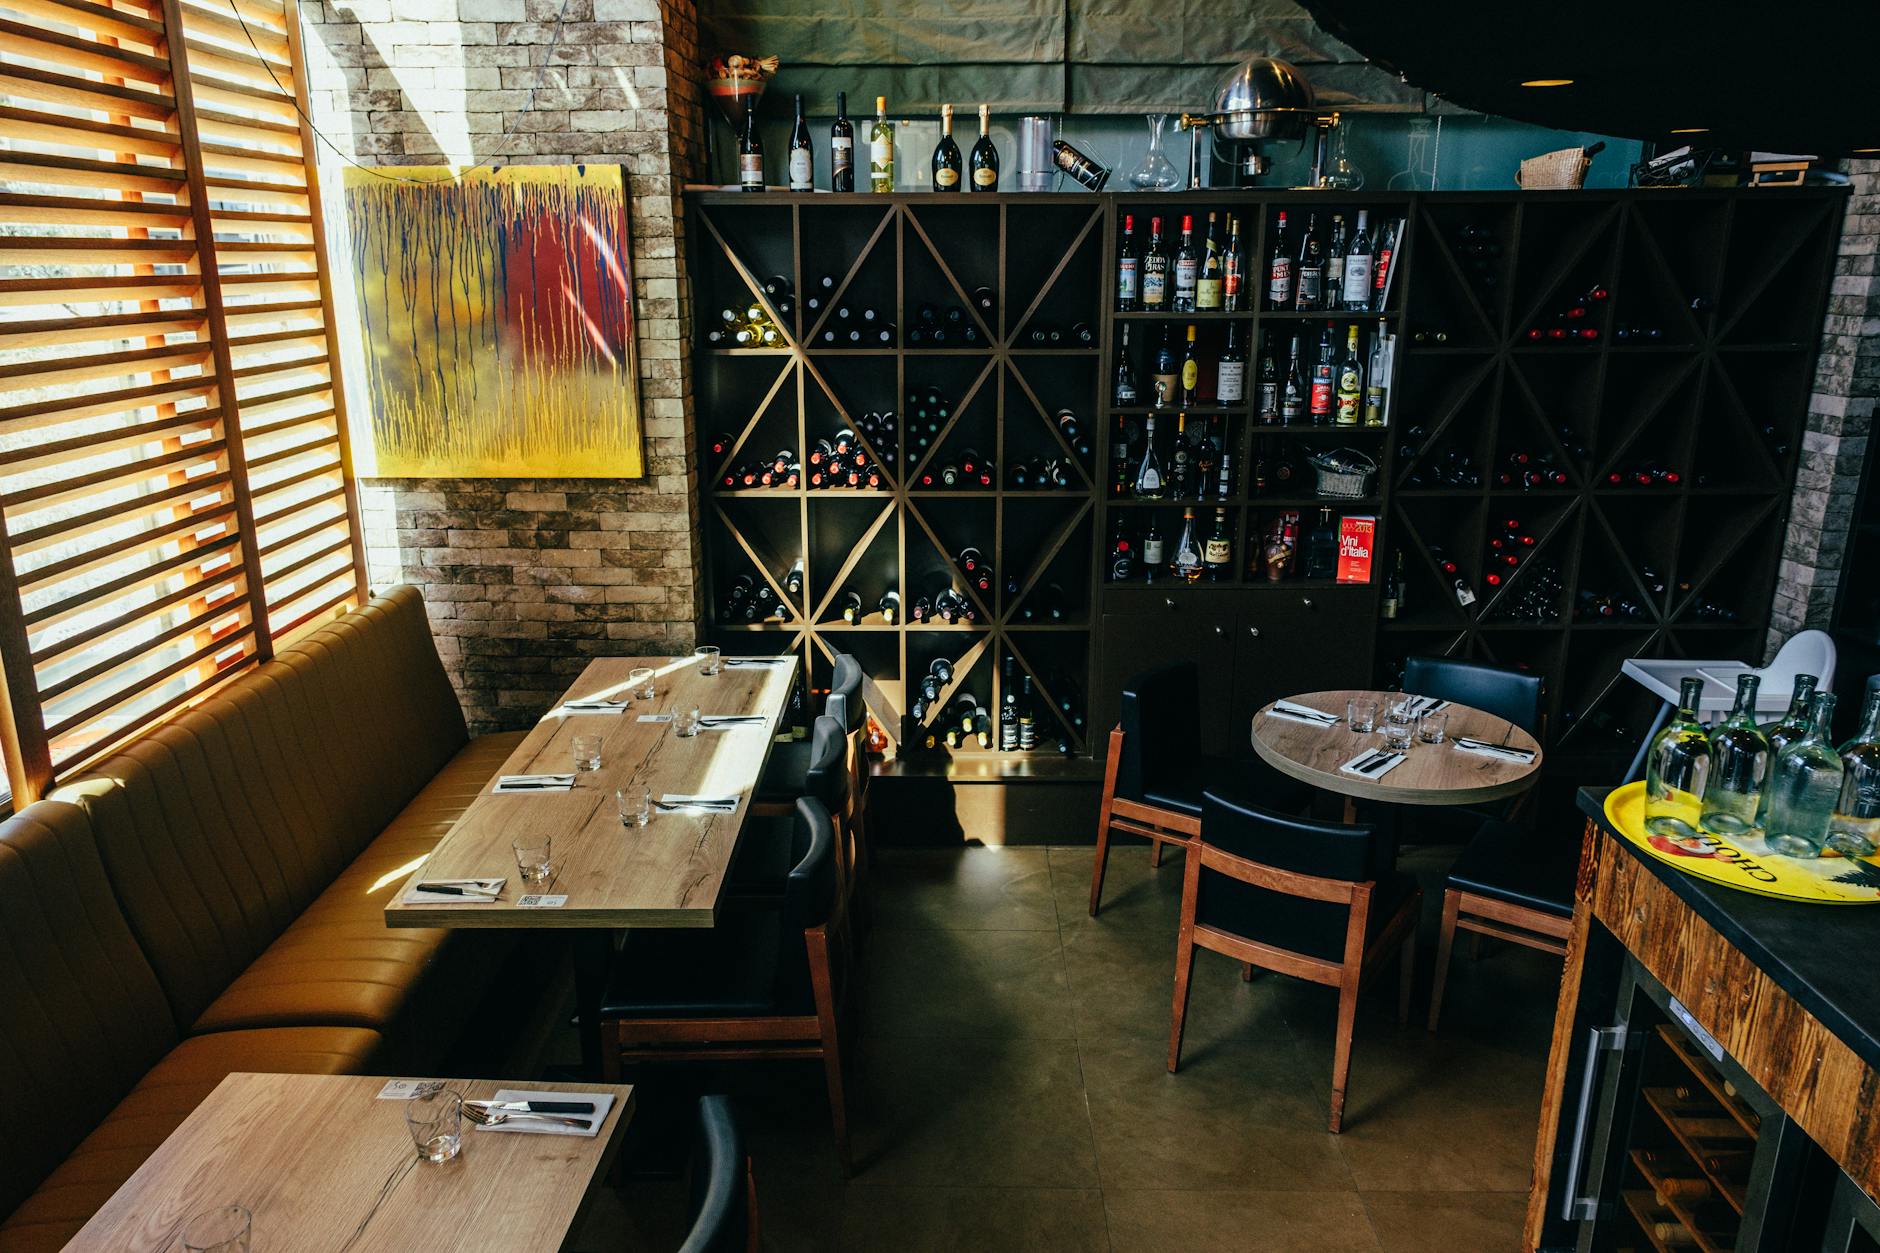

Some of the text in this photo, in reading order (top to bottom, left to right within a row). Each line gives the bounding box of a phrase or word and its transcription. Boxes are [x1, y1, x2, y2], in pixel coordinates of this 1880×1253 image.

[1356, 525, 1372, 533] 2013
[1342, 535, 1358, 546] Vini
[1341, 546, 1369, 558] d'Italia
